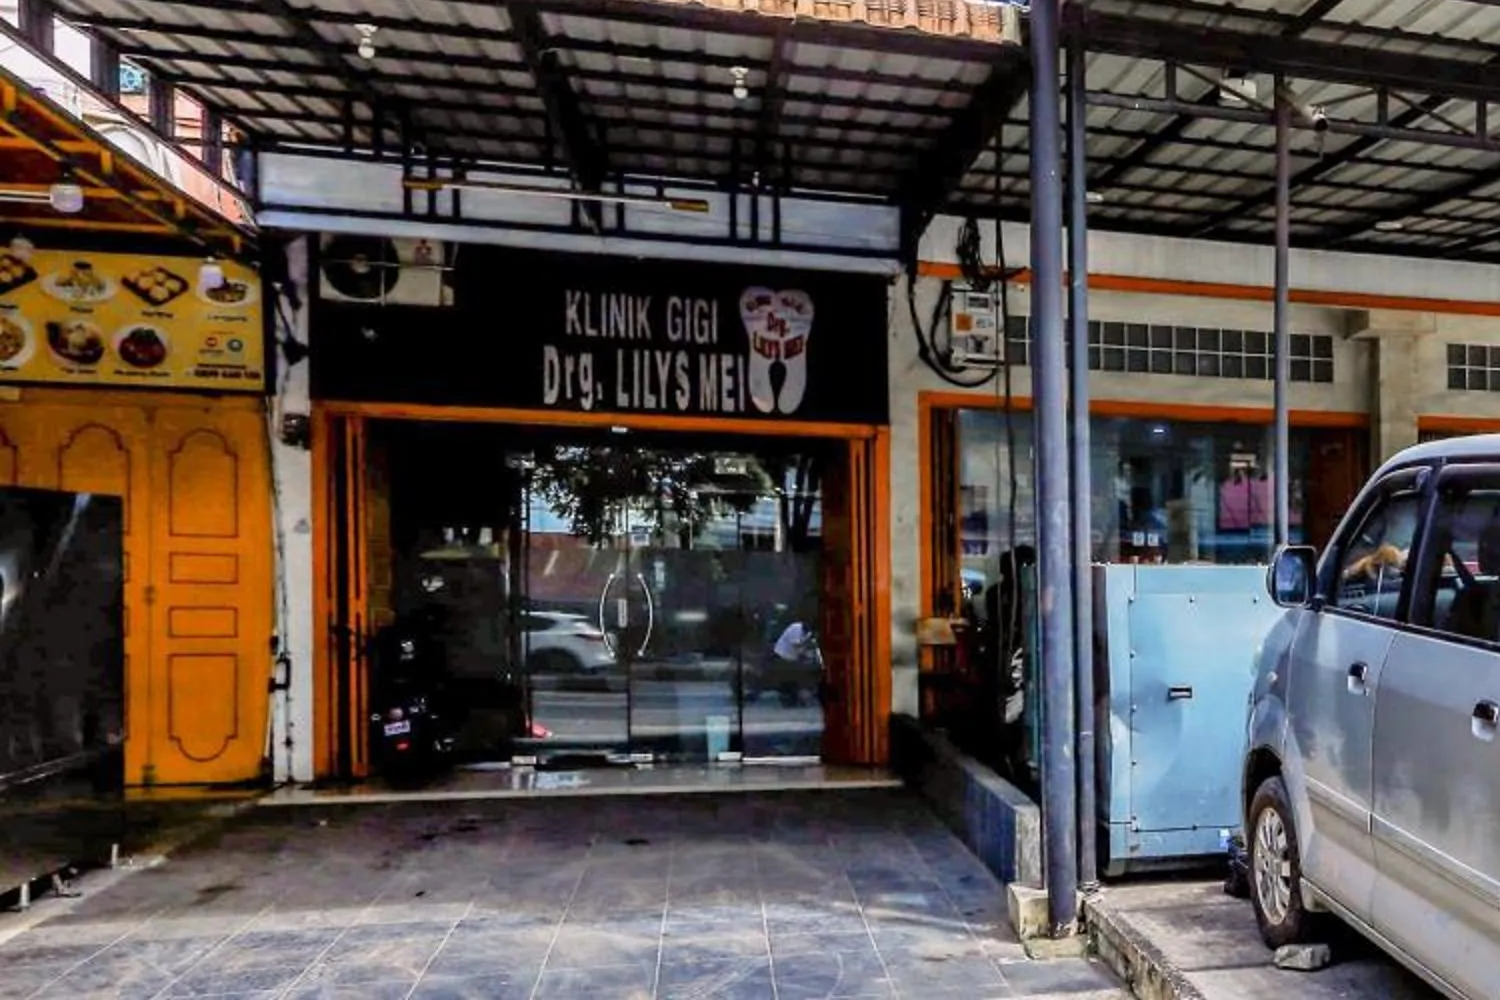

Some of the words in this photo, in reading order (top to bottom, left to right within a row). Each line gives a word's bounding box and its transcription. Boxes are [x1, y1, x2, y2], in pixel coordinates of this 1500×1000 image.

[565, 290, 651, 340] KLINIK
[667, 296, 718, 345] GIGI
[544, 345, 603, 412] Drg.
[616, 348, 691, 411] LILYS
[699, 353, 746, 413] MEI
